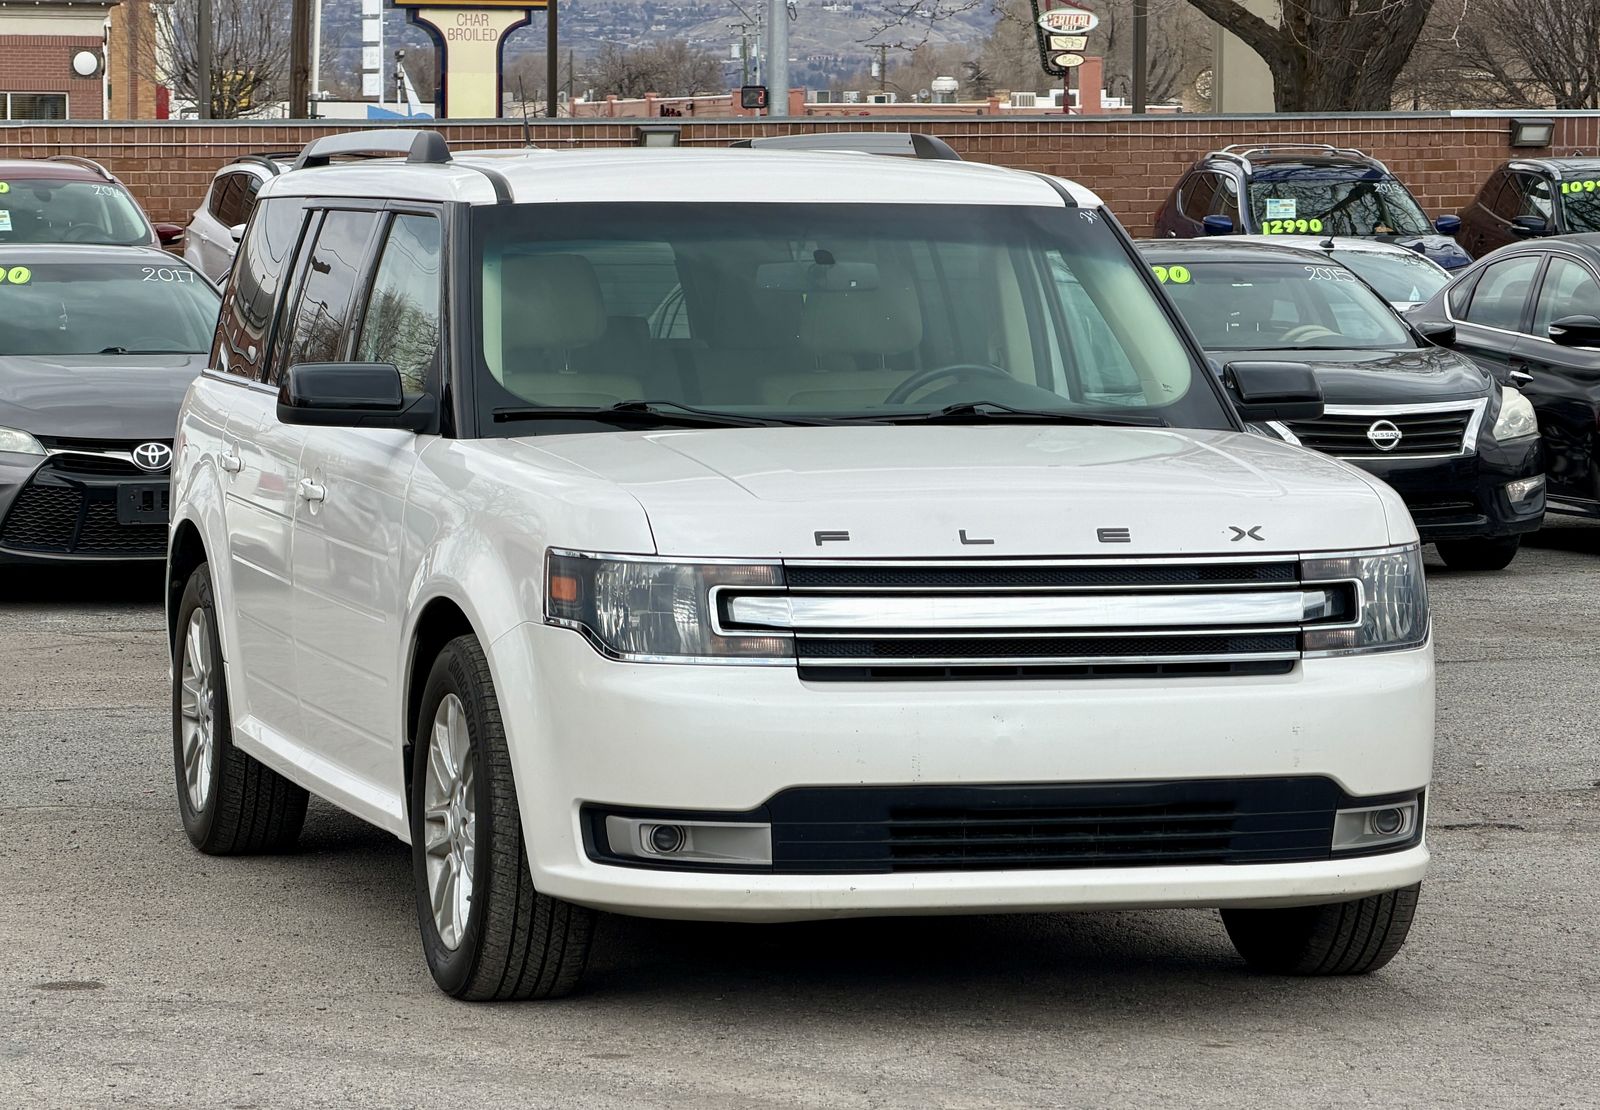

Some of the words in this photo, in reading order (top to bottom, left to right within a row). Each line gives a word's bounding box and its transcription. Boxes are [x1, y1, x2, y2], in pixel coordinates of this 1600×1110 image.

[456, 13, 489, 26] CHAR
[447, 28, 498, 41] BROILED
[1262, 218, 1323, 235] 12990
[141, 267, 195, 283] 2017
[1304, 266, 1356, 282] 2015
